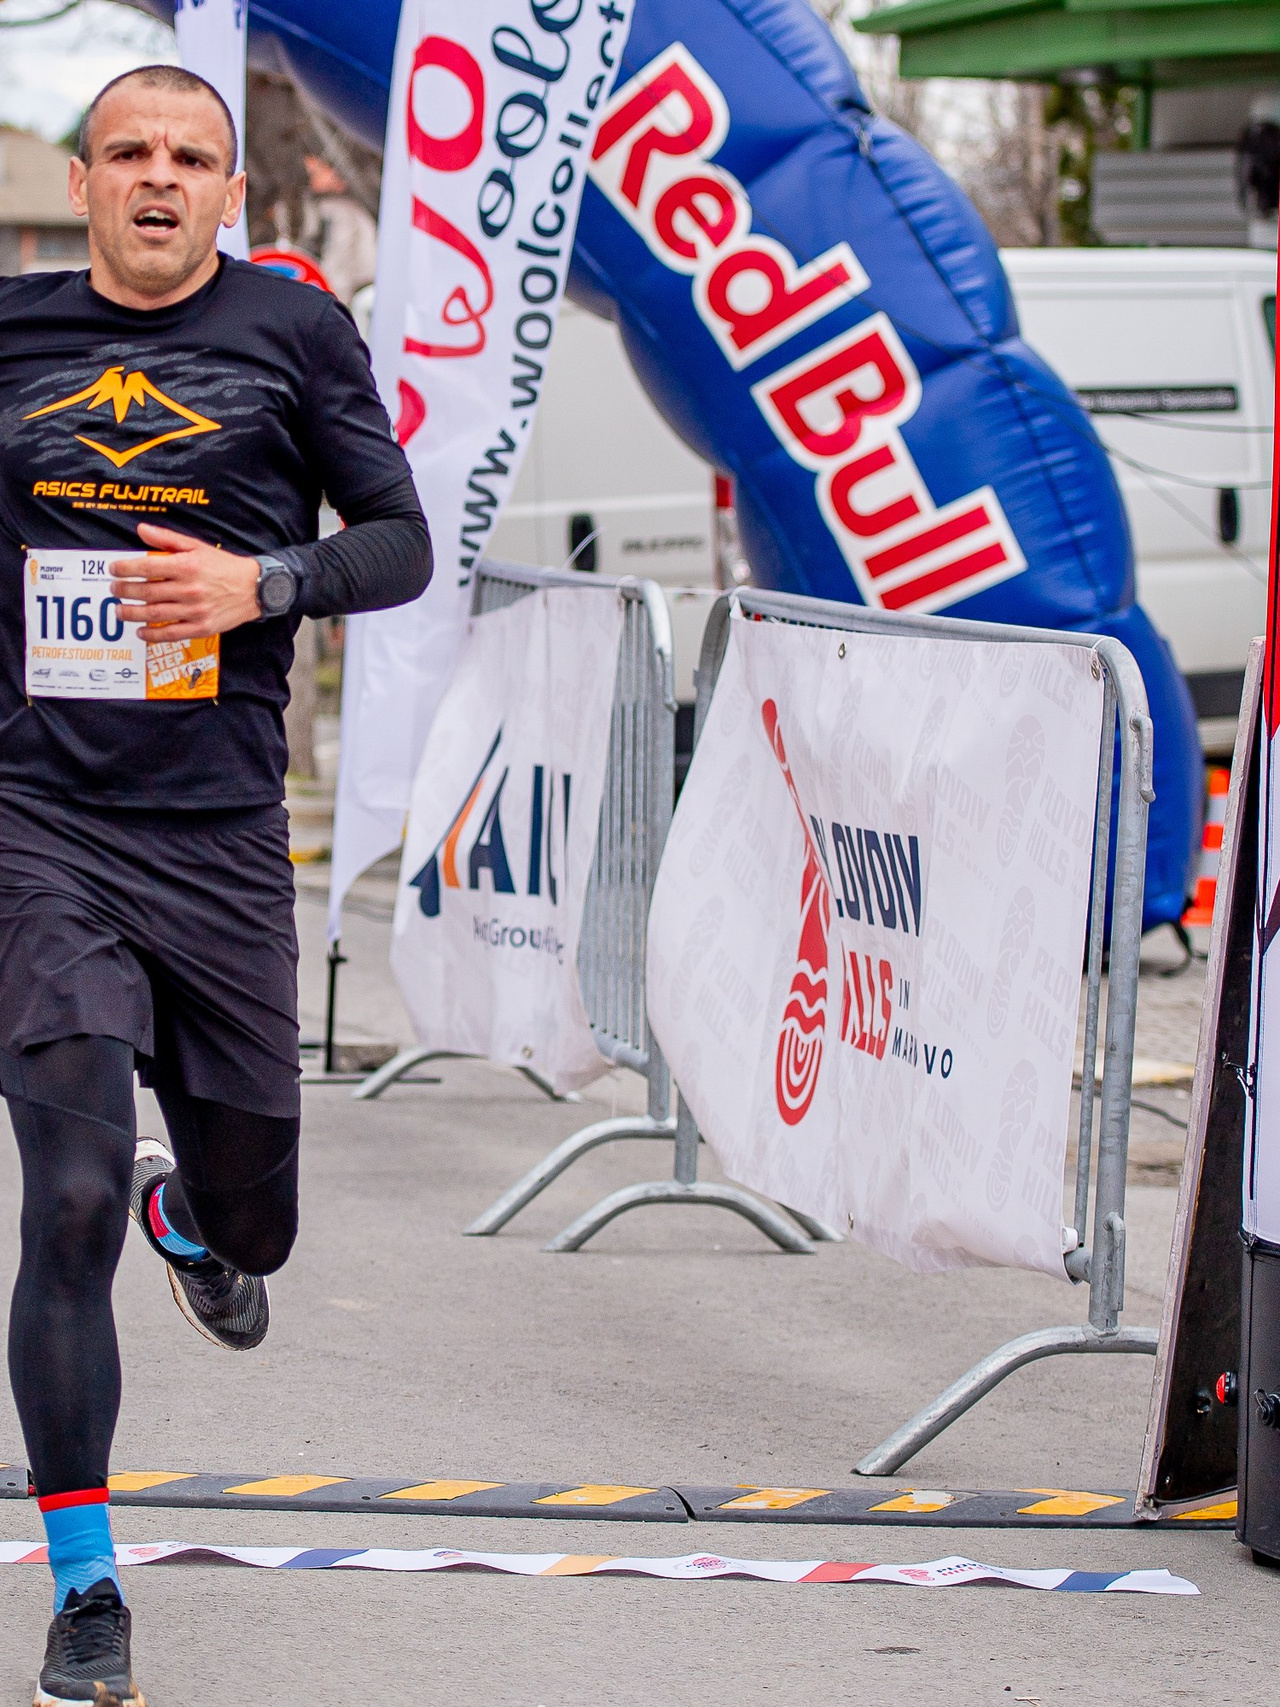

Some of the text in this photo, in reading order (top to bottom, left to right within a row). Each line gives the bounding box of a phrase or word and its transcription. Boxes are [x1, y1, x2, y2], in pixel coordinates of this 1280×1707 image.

[592, 60, 1011, 612] Red Bull
[33, 481, 210, 505] ASICS FUJITRAIL
[82, 560, 105, 575] 12K
[36, 595, 124, 642] 1160
[107, 648, 133, 661] TRAIL
[898, 976, 911, 1011] IN
[1020, 990, 1070, 1063] HILLS
